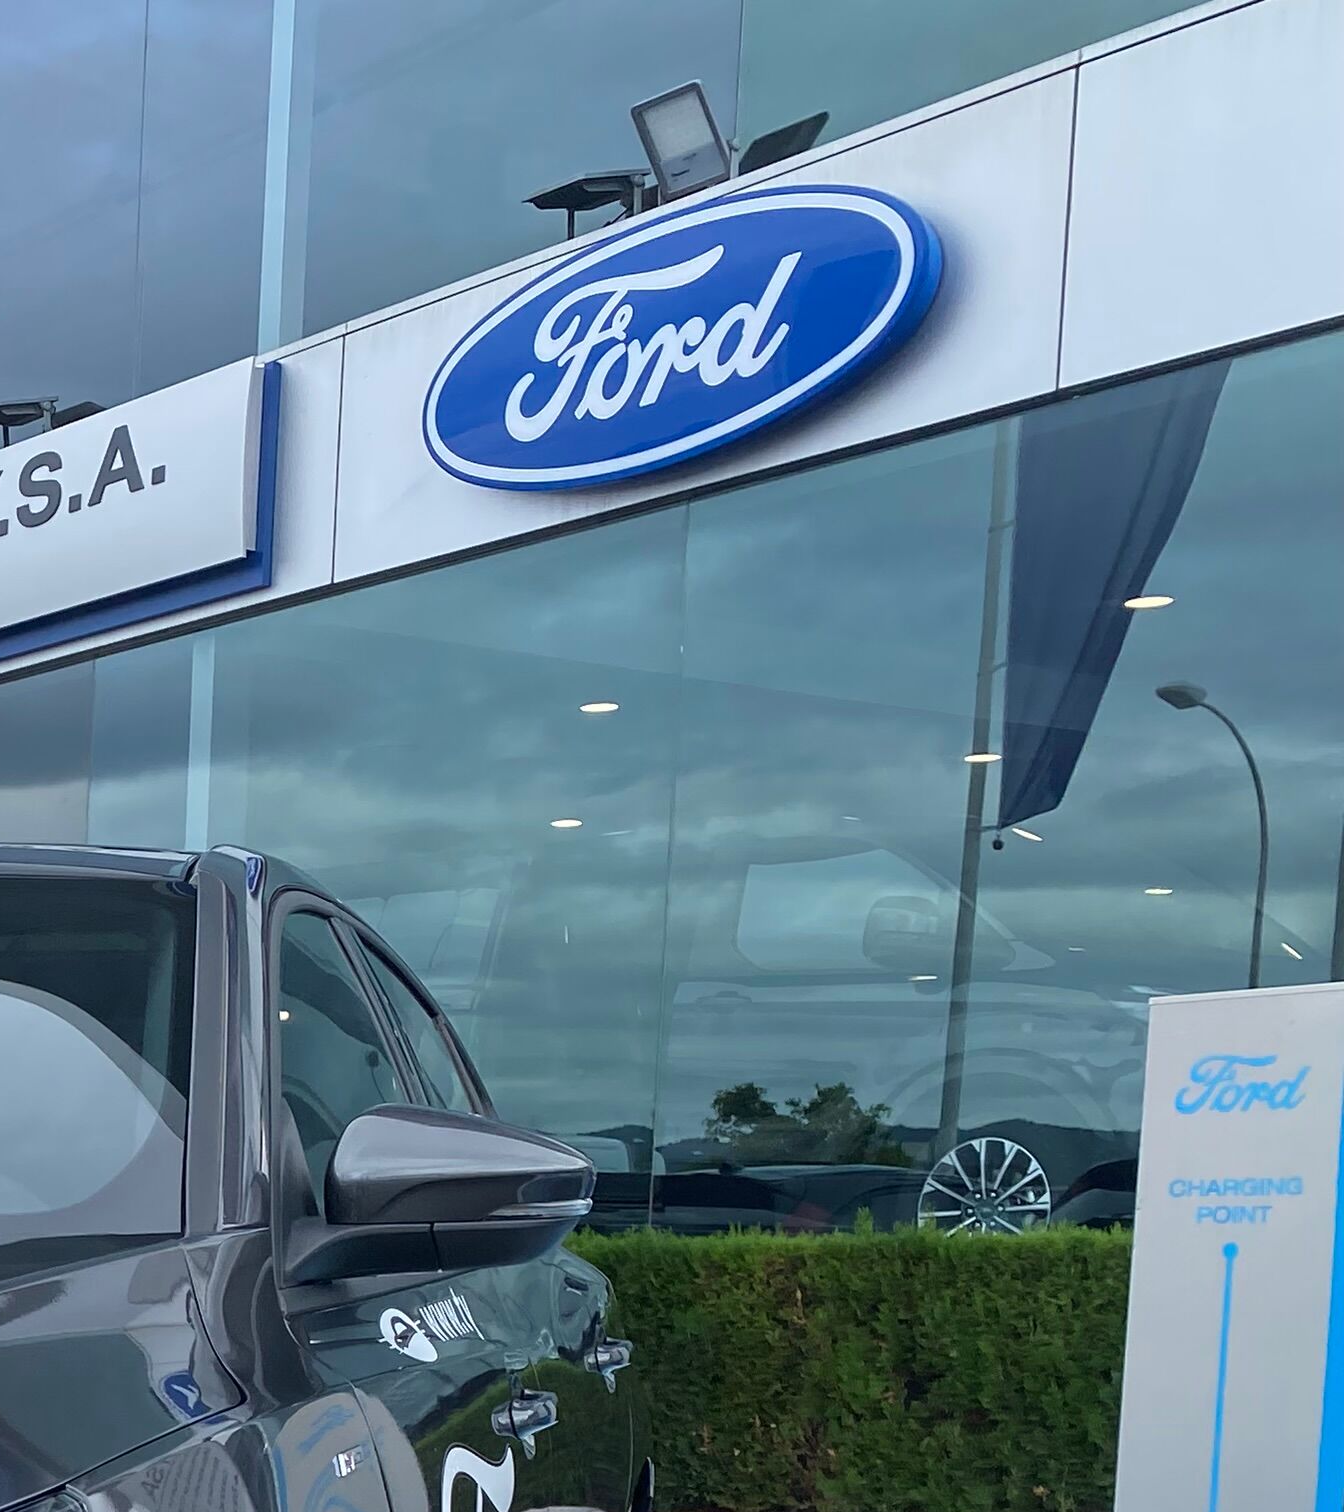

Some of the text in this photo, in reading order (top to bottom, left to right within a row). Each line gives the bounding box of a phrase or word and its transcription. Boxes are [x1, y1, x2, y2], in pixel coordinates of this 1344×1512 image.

[504, 243, 802, 443] Ford
[1174, 1054, 1311, 1115] Ford
[1169, 1177, 1302, 1199] CHARGING
[1196, 1205, 1273, 1225] POINT
